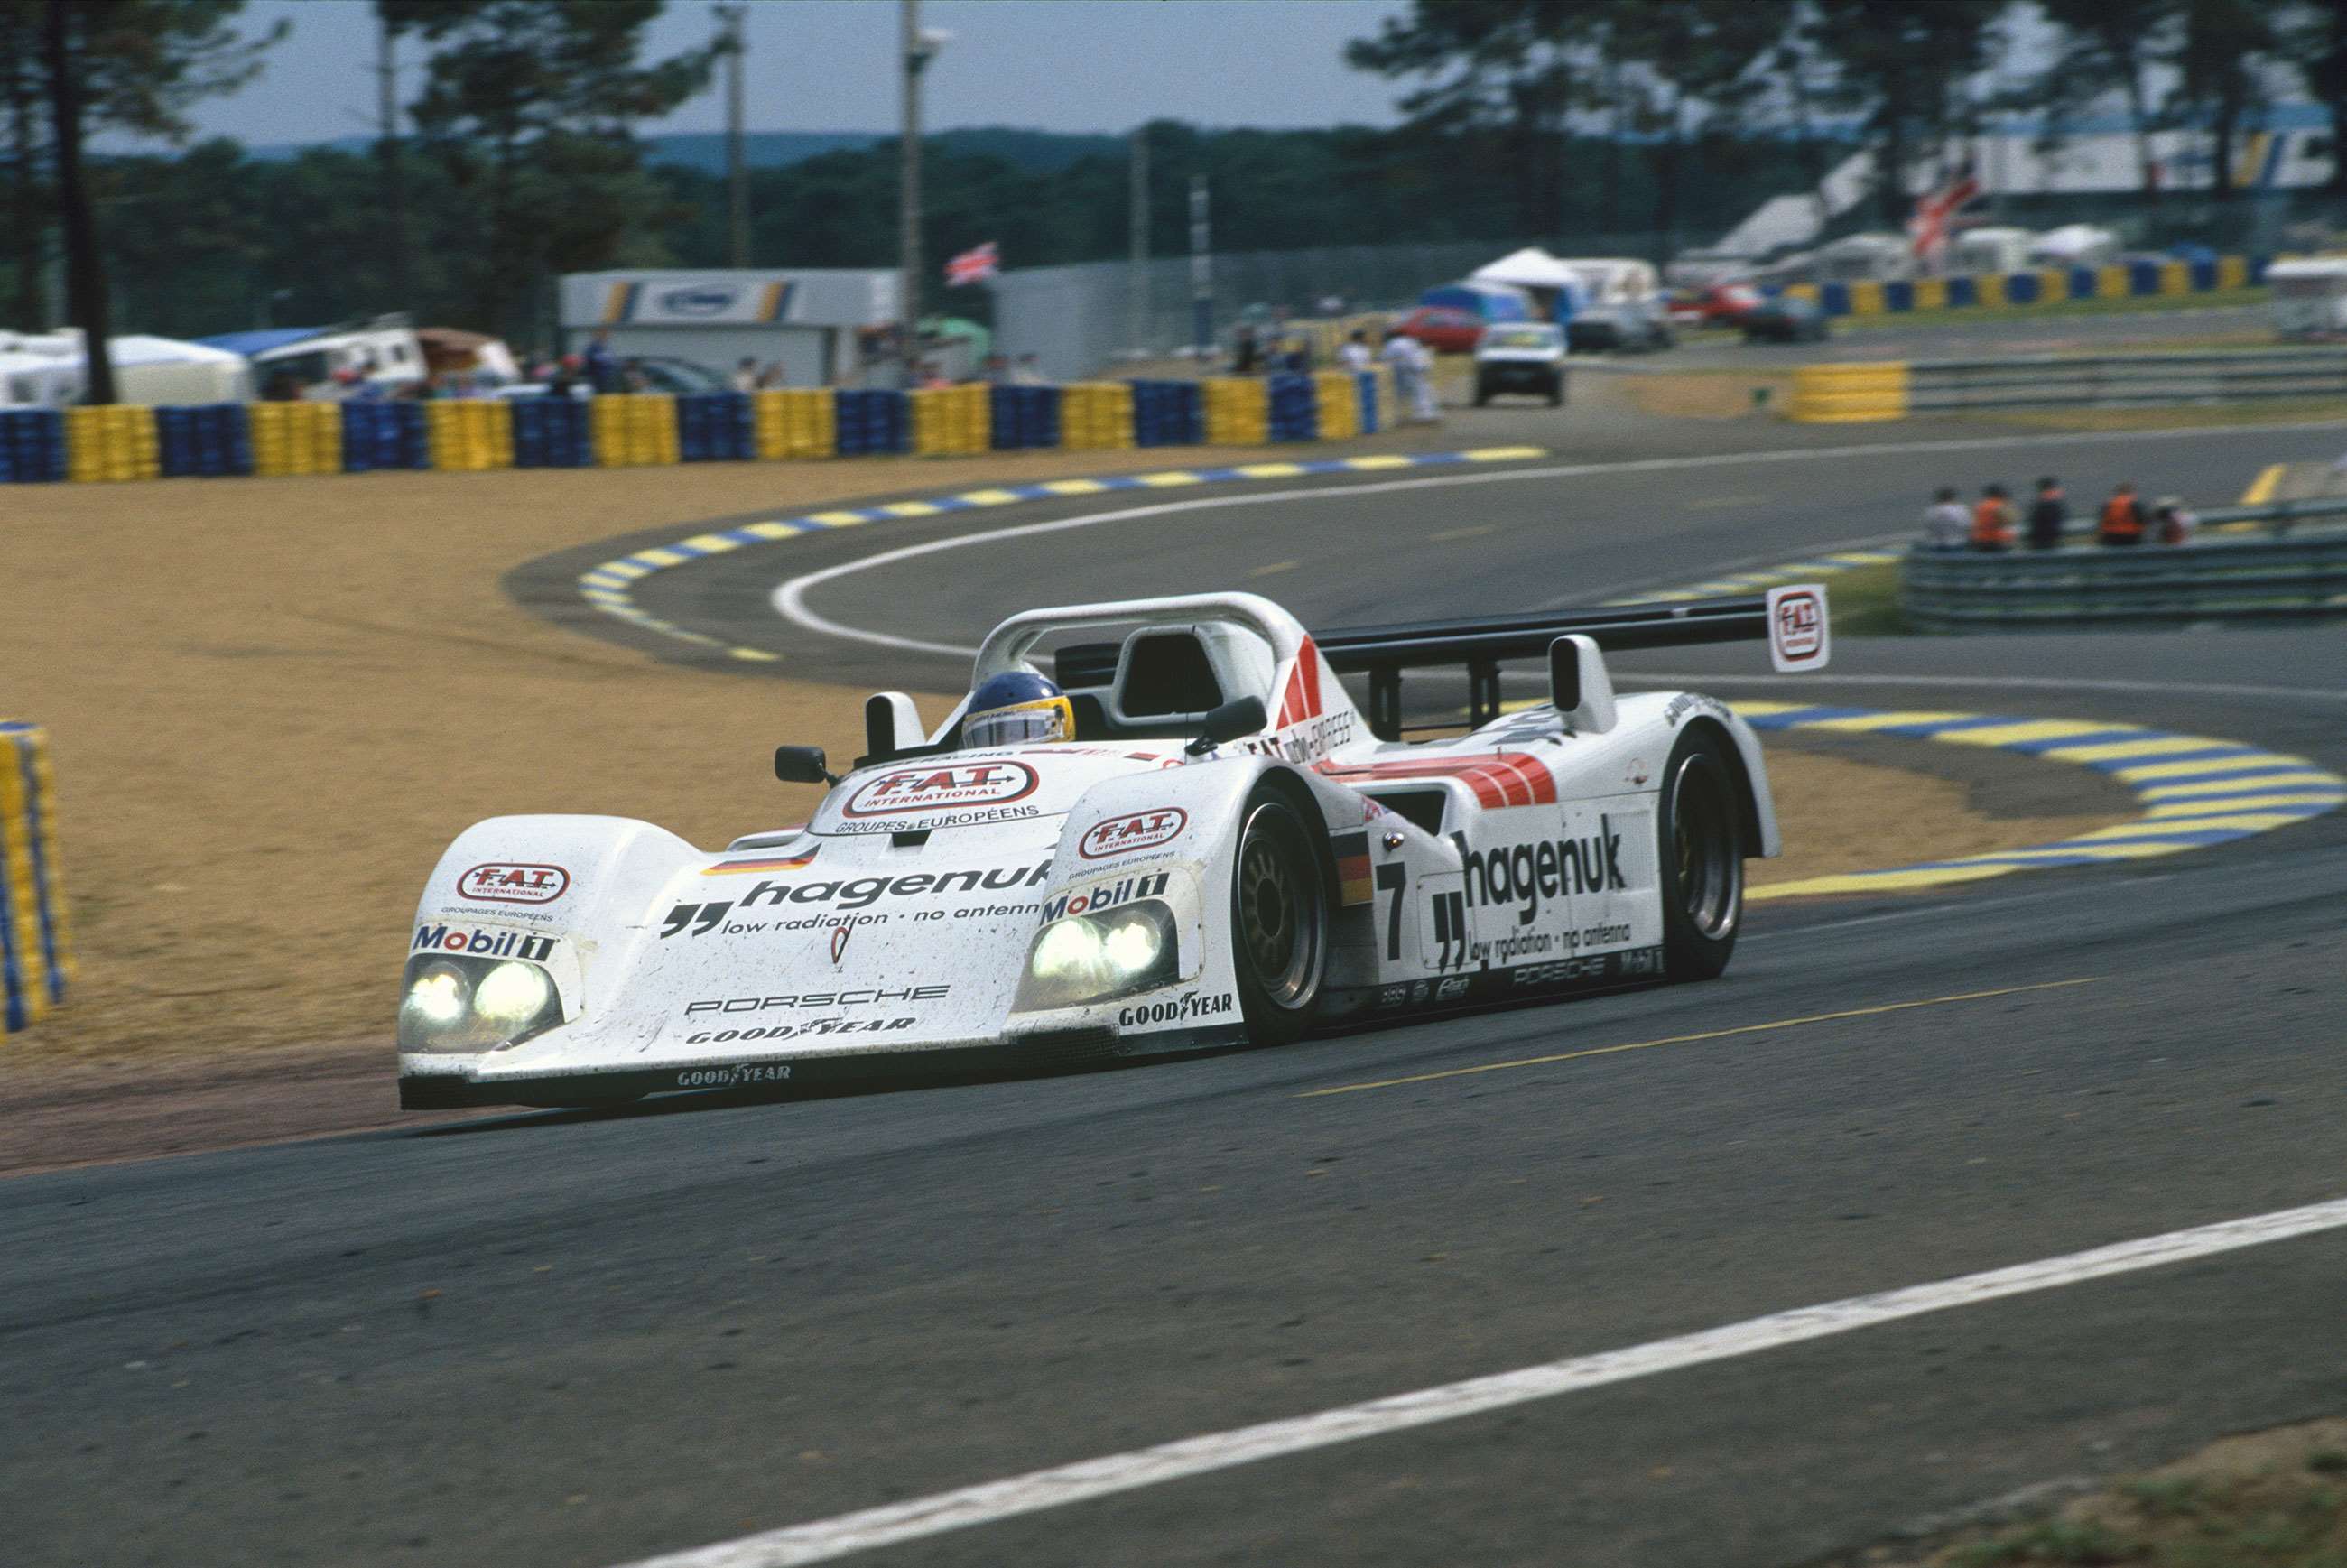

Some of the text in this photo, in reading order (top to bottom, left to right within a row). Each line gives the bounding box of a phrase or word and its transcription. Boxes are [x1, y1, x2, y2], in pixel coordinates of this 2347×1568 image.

[864, 788, 1002, 808] INTERNATIONAL
[835, 804, 1040, 833] GROUPES EUROPÉENS
[1094, 833, 1164, 852] INTERNATIONAL
[1069, 861, 1120, 880] GROUPAGES
[1450, 813, 1628, 925] hagenuk
[471, 887, 544, 897] INTERNATIONAL
[1040, 878, 1134, 926] Mobil
[441, 906, 496, 916] GROUPAGES
[721, 903, 1039, 934] low radiation no antenn
[1375, 862, 1406, 961] 7
[412, 925, 518, 958] Mobil
[1469, 922, 1631, 961] low radiation no antenna
[684, 985, 951, 1016] PORSCHE
